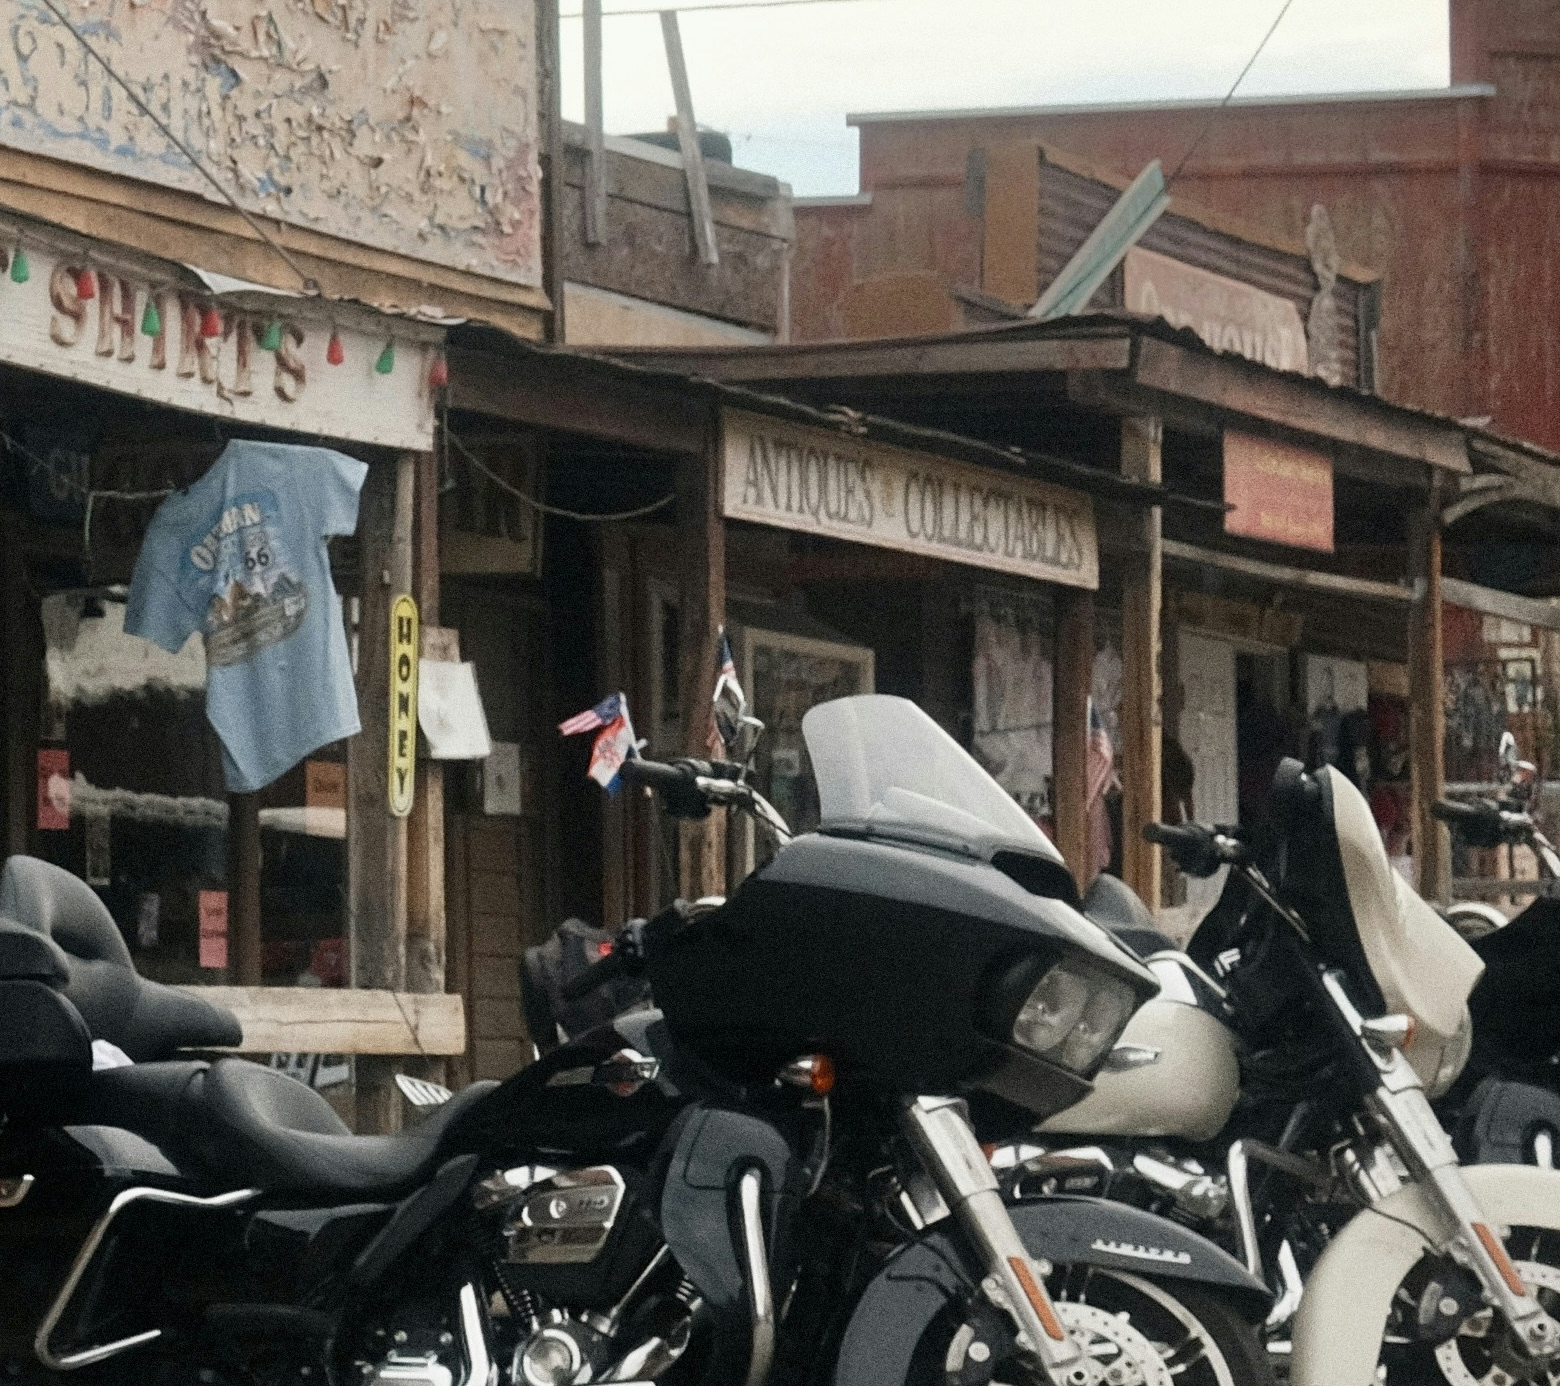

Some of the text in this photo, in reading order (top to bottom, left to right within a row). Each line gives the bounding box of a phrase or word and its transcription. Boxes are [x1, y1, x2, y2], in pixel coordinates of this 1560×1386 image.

[48, 261, 308, 404] SHIRTS
[243, 547, 270, 571] 66
[742, 433, 1083, 572] ANTIQUES COLLECTABLES
[396, 616, 412, 798] HONEY
